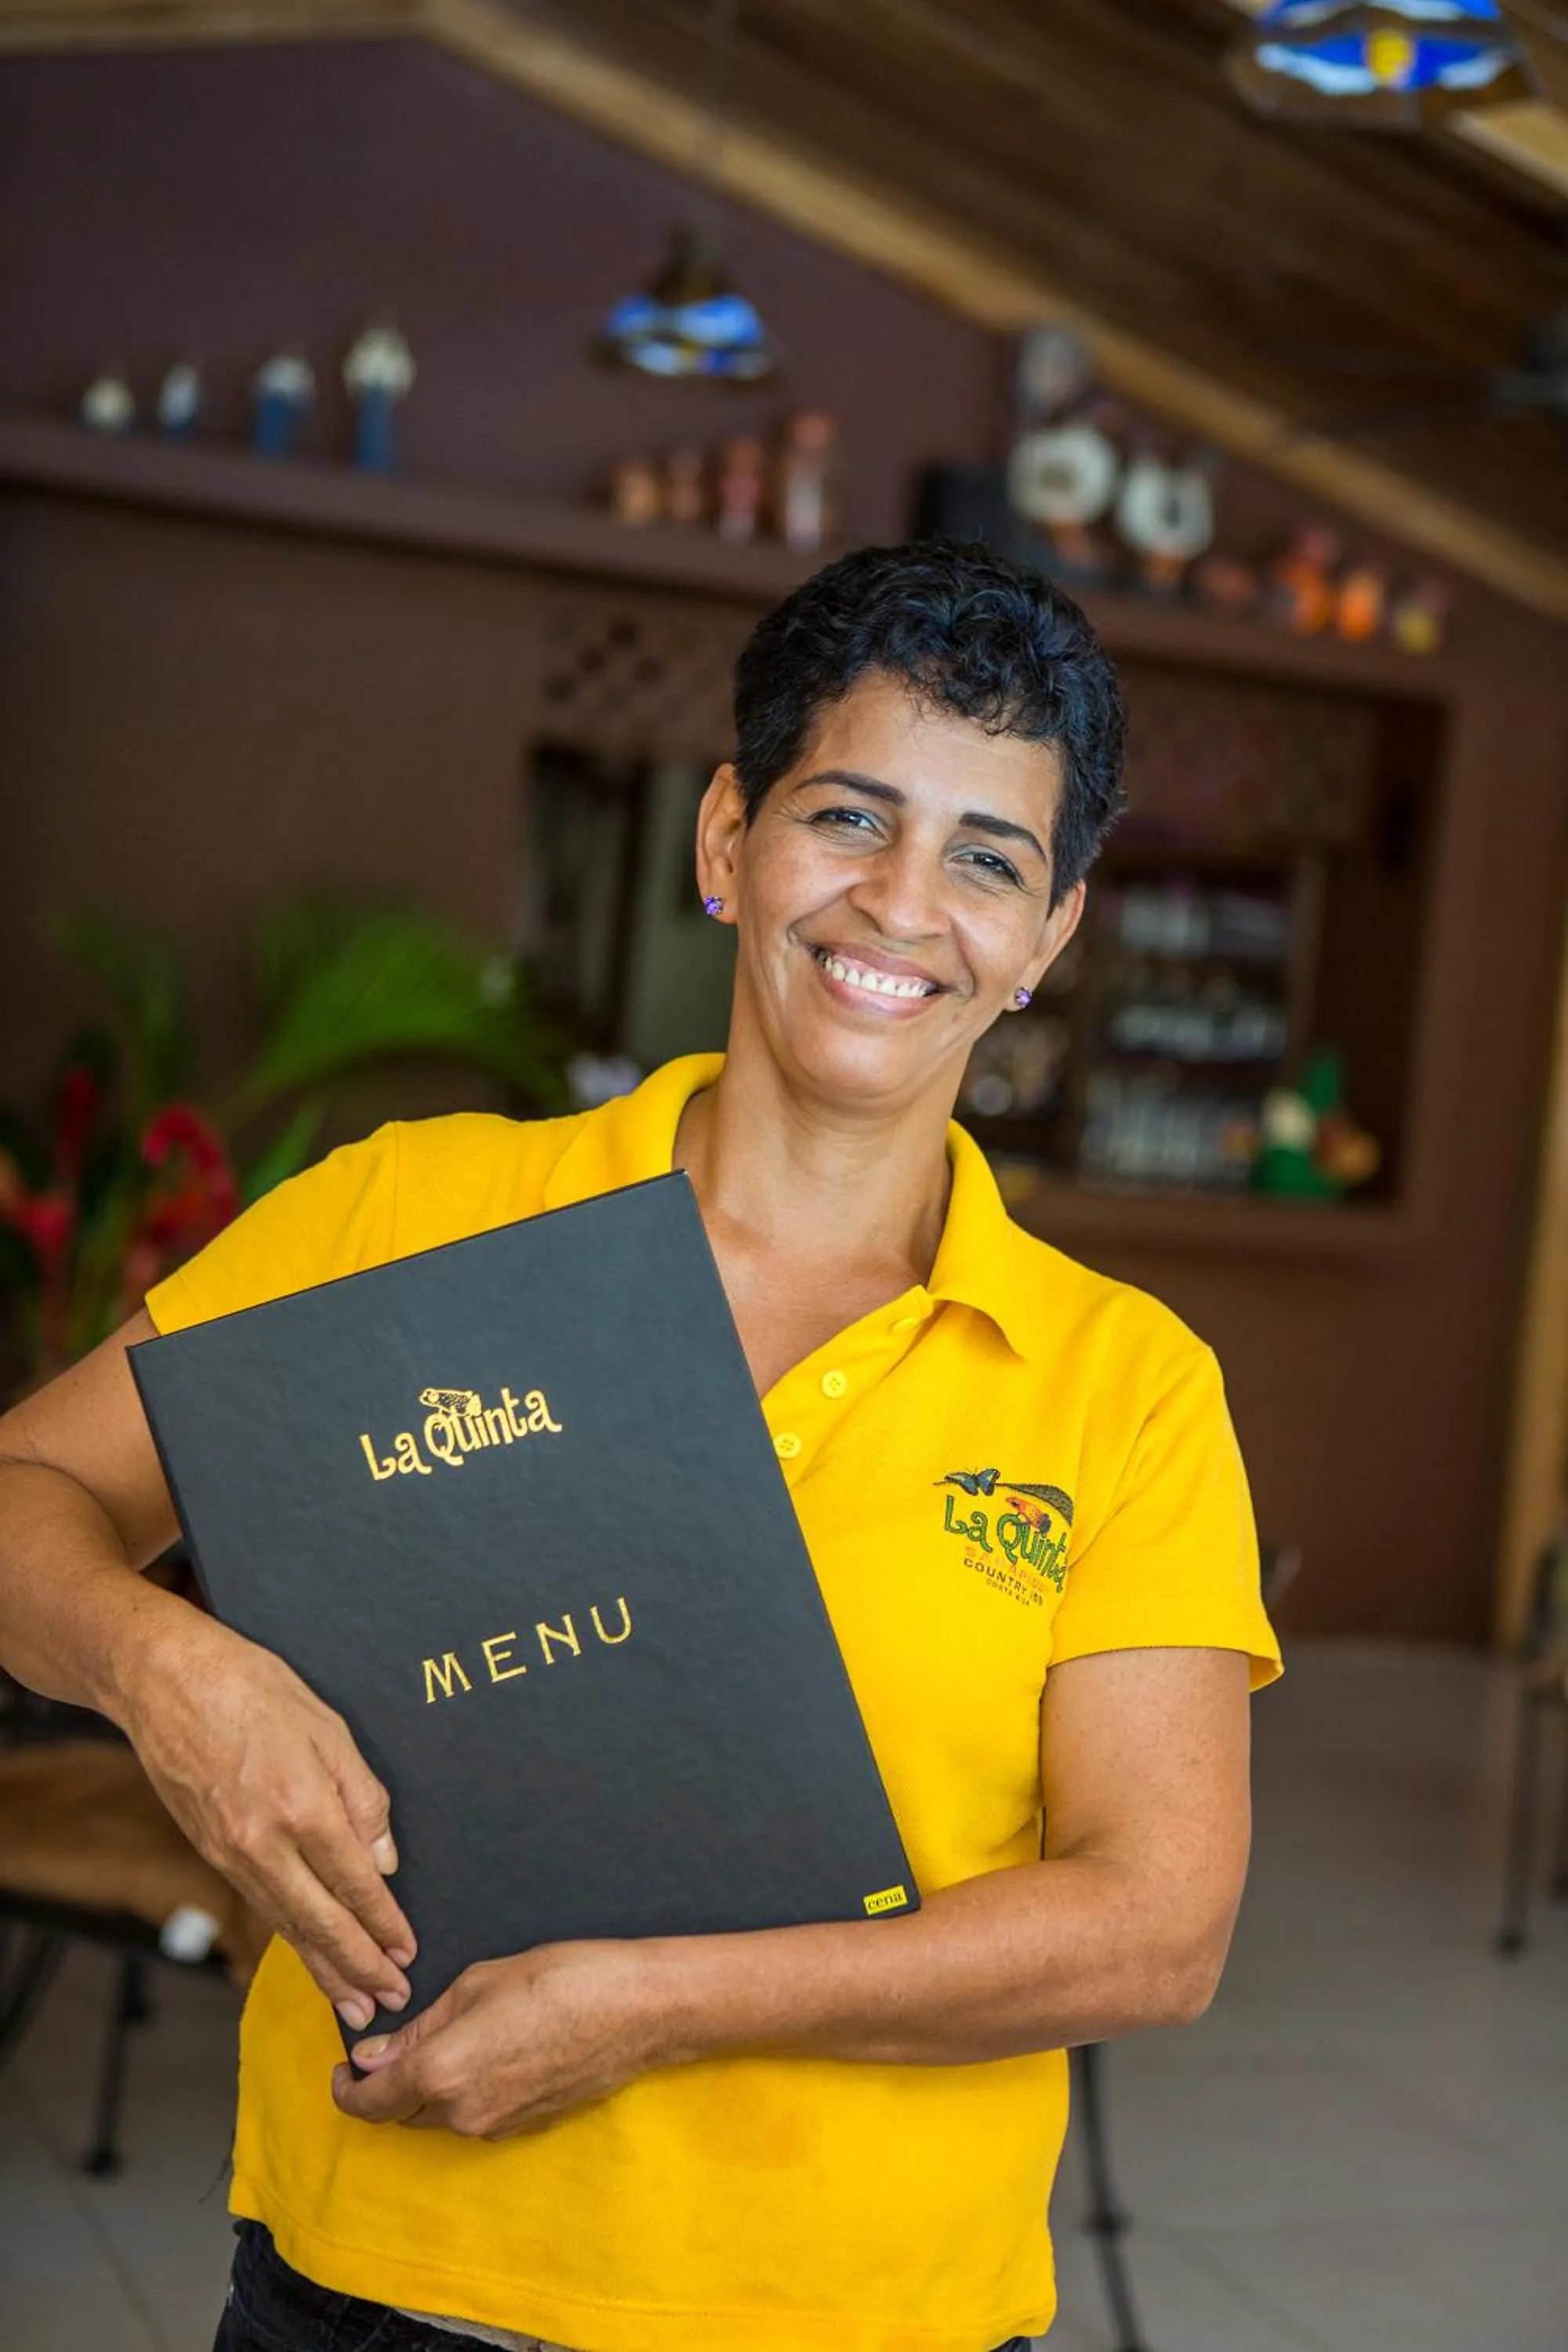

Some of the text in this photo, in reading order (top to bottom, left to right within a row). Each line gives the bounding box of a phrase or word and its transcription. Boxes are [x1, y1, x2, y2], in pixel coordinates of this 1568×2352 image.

[359, 1387, 562, 1480] La Quinta
[944, 1495, 993, 1553] La
[964, 1558, 1027, 1595] COUNTRY
[422, 1596, 632, 1704] MENU
[868, 1893, 902, 1910] cena
